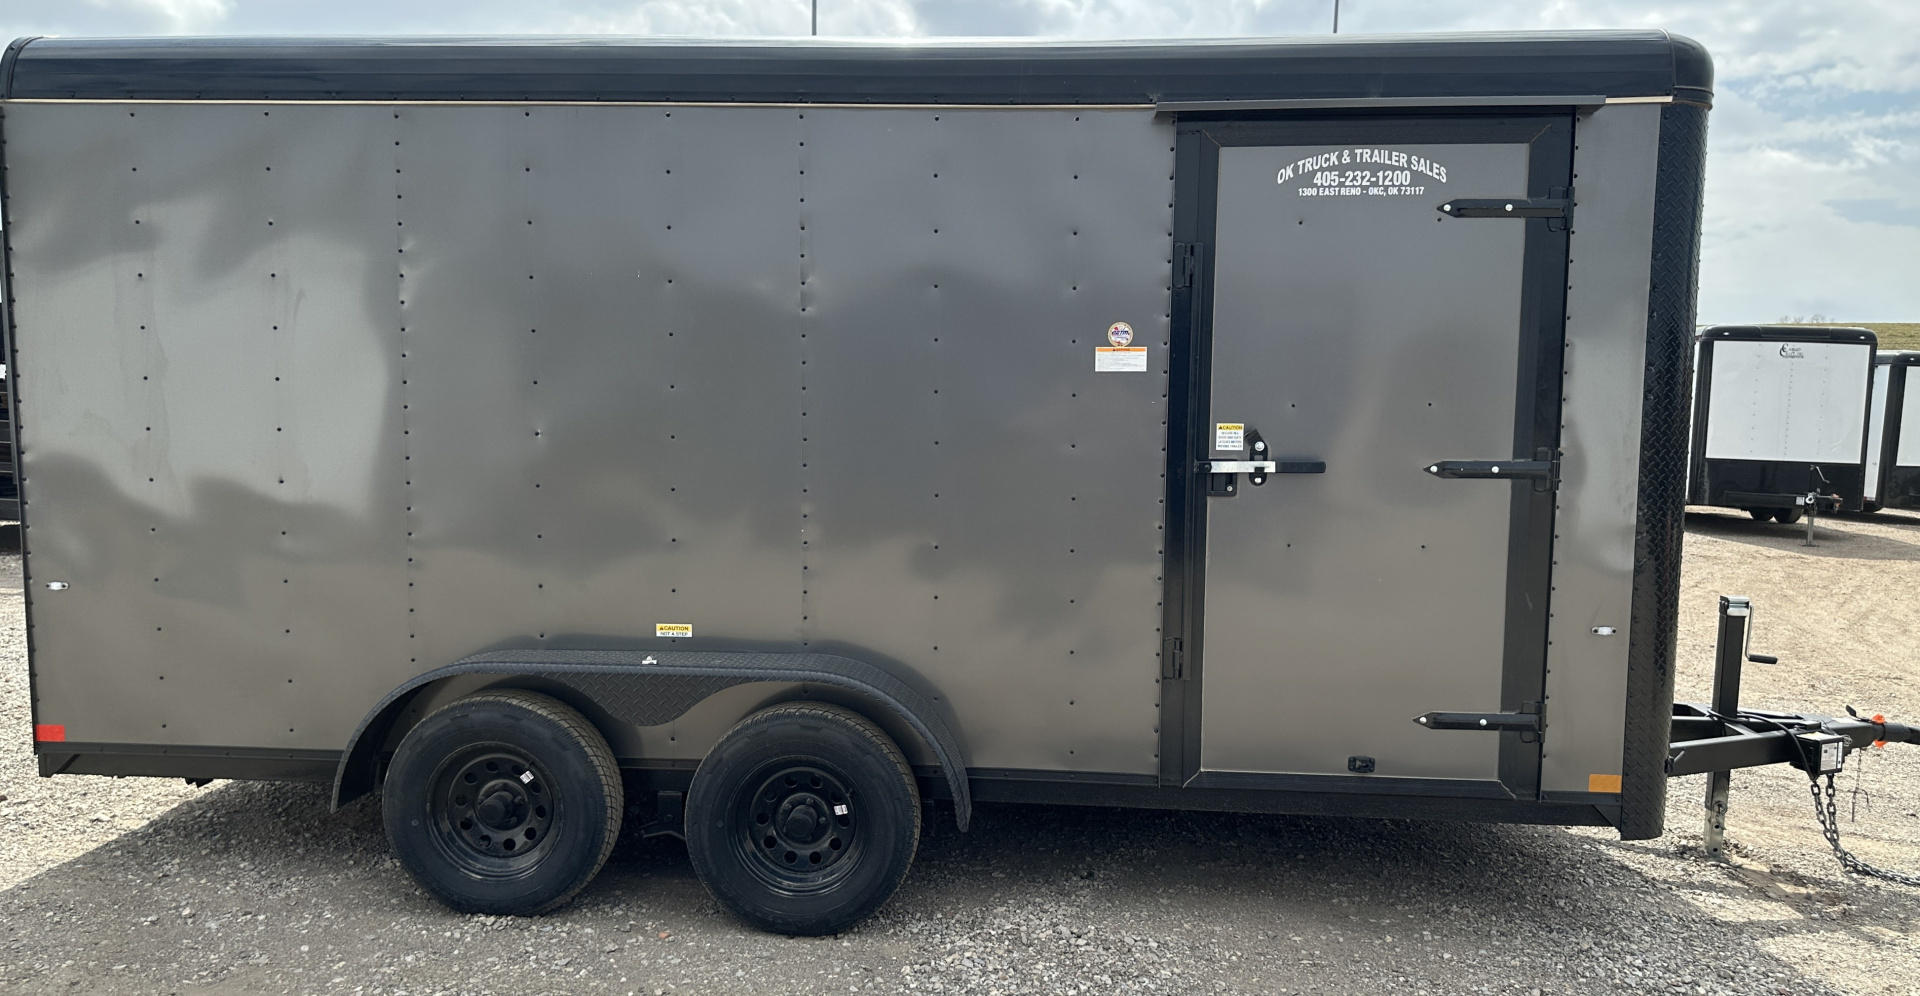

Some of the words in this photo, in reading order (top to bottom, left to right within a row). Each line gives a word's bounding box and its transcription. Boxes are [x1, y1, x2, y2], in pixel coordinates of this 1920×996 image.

[1277, 163, 1295, 185] OK
[1297, 151, 1339, 175] TRUCK
[1341, 149, 1351, 164] &
[1354, 148, 1408, 168] TRAILER
[1410, 155, 1447, 184] SALES
[1313, 170, 1411, 187] 405-232-1200
[1298, 187, 1317, 197] 1300
[1318, 187, 1339, 196] EAST
[1340, 187, 1361, 196] RENO
[1368, 187, 1387, 197] OKC,
[1388, 186, 1399, 195] OK
[1400, 186, 1425, 195] 73117
